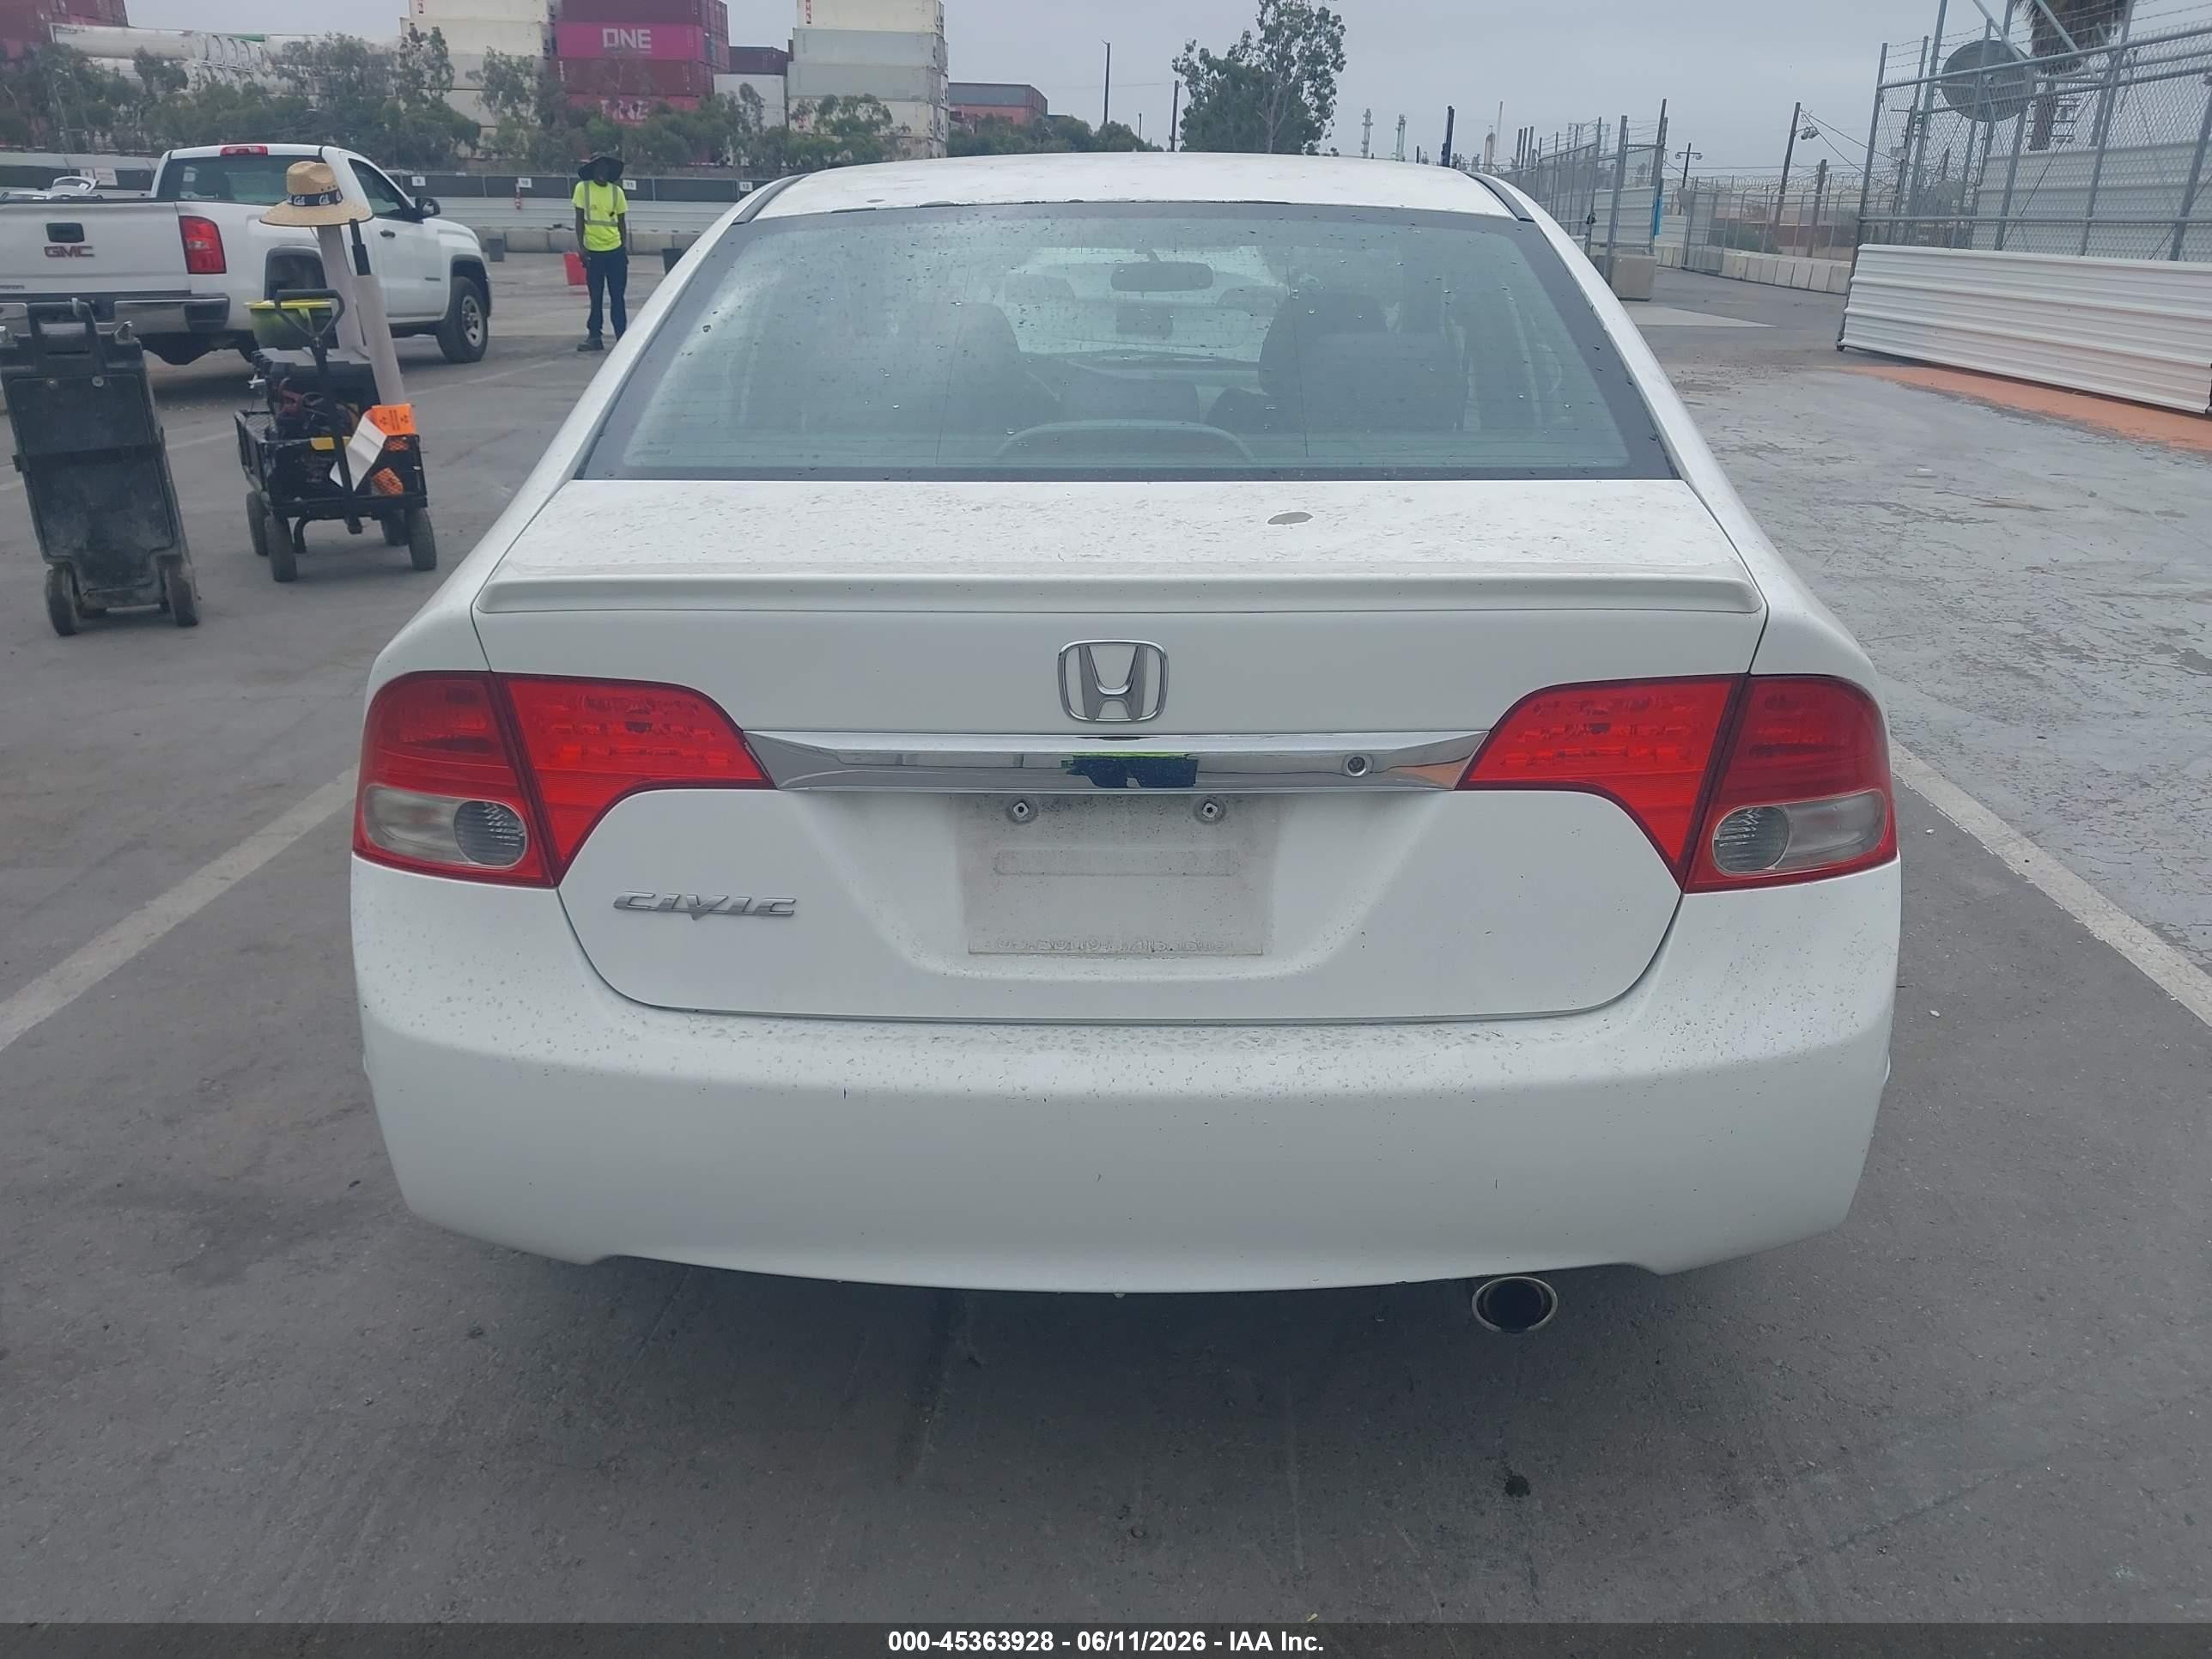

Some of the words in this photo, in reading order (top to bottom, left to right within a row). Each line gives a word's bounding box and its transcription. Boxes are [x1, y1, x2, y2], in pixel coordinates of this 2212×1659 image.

[602, 27, 652, 49] ONE
[44, 246, 95, 258] GMC
[613, 890, 797, 921] CIVIC
